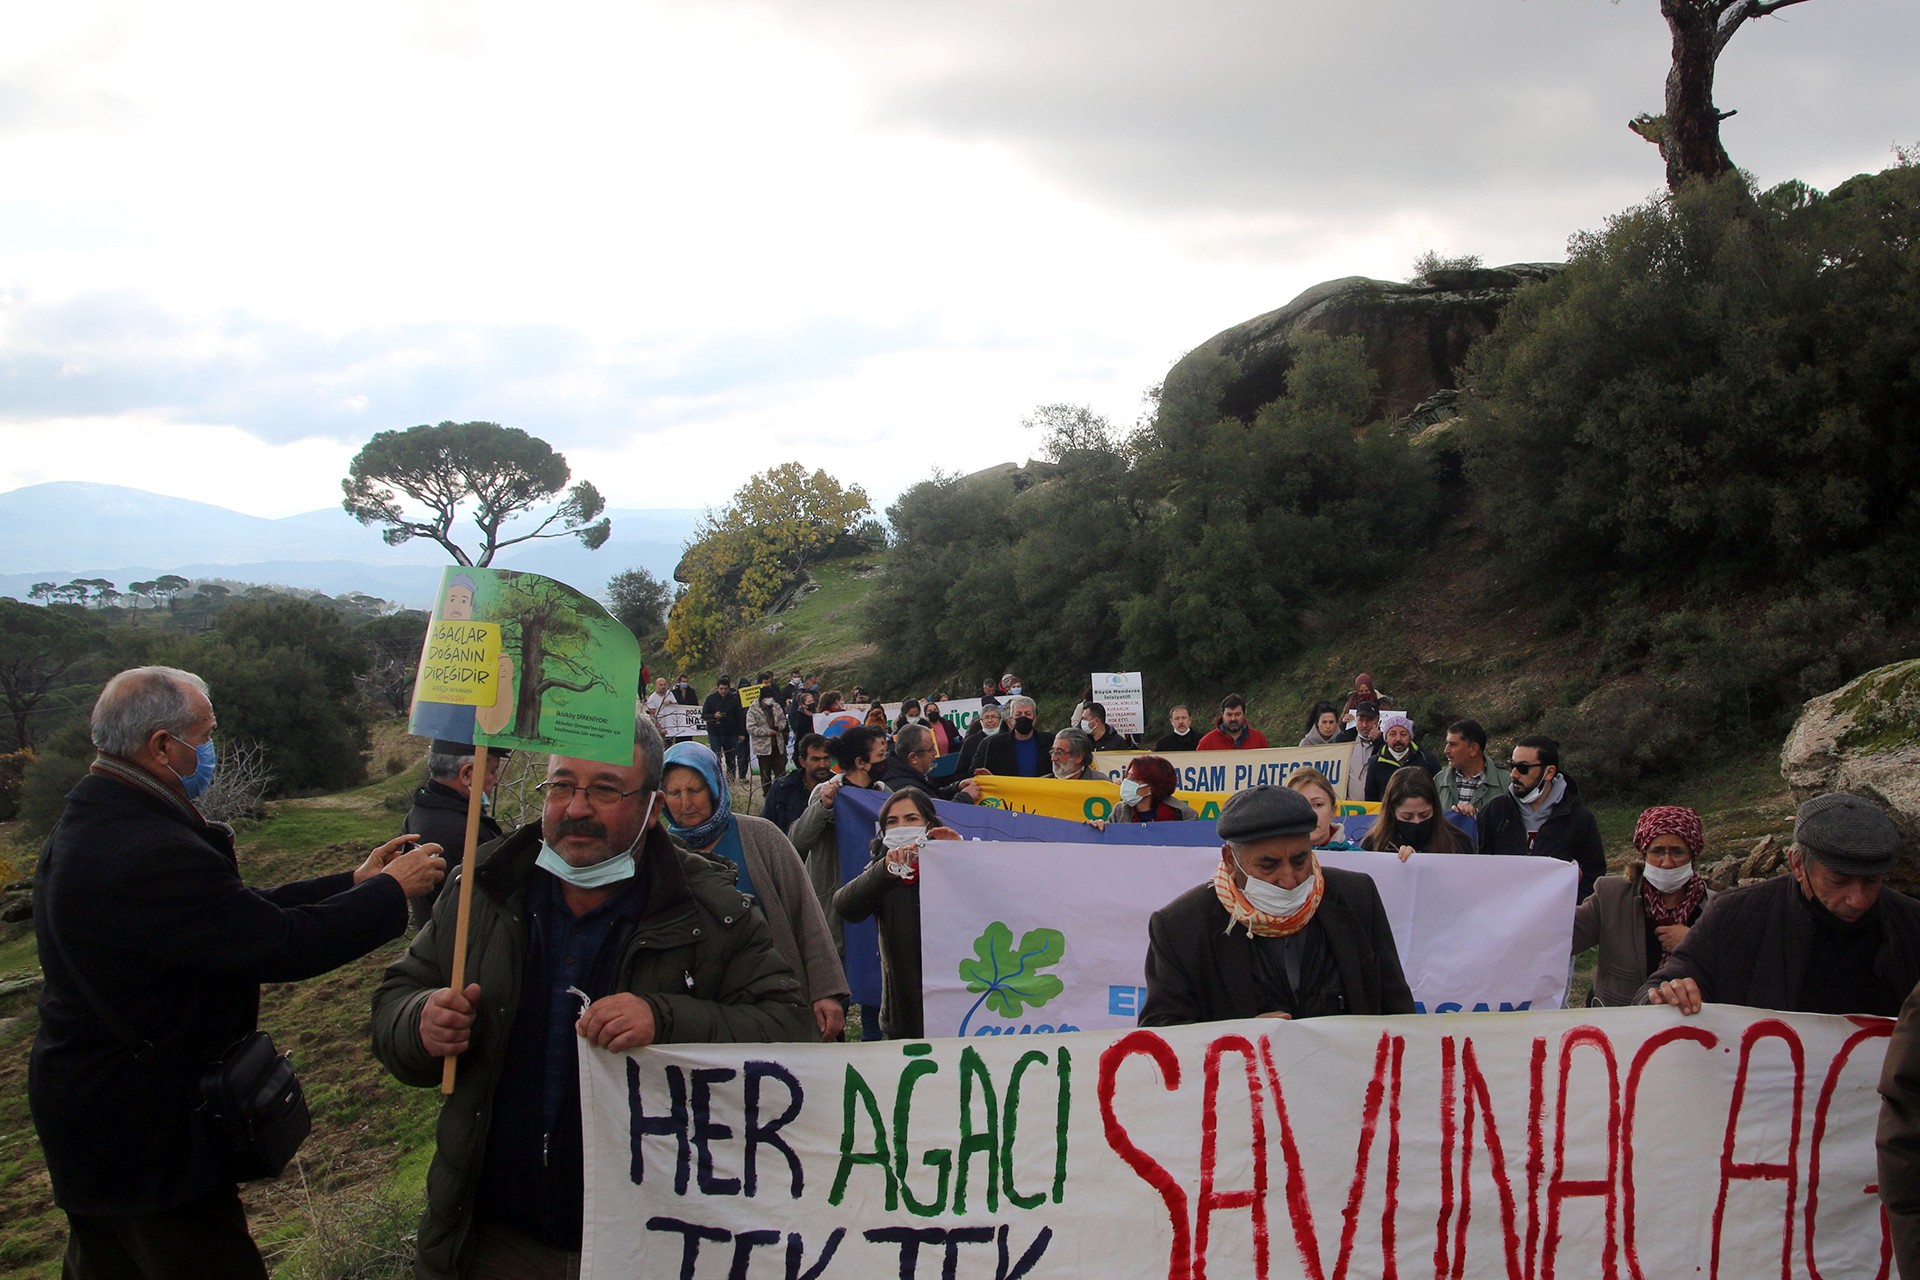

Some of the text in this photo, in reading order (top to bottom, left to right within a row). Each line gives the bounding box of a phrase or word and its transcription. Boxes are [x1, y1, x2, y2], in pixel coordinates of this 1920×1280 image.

[432, 624, 487, 645] AĞAÇLAR
[430, 644, 484, 664] DOĞANIN
[1234, 759, 1342, 790] PLATFMU
[626, 1055, 804, 1198] HER
[827, 1043, 1071, 1217] AĞACI
